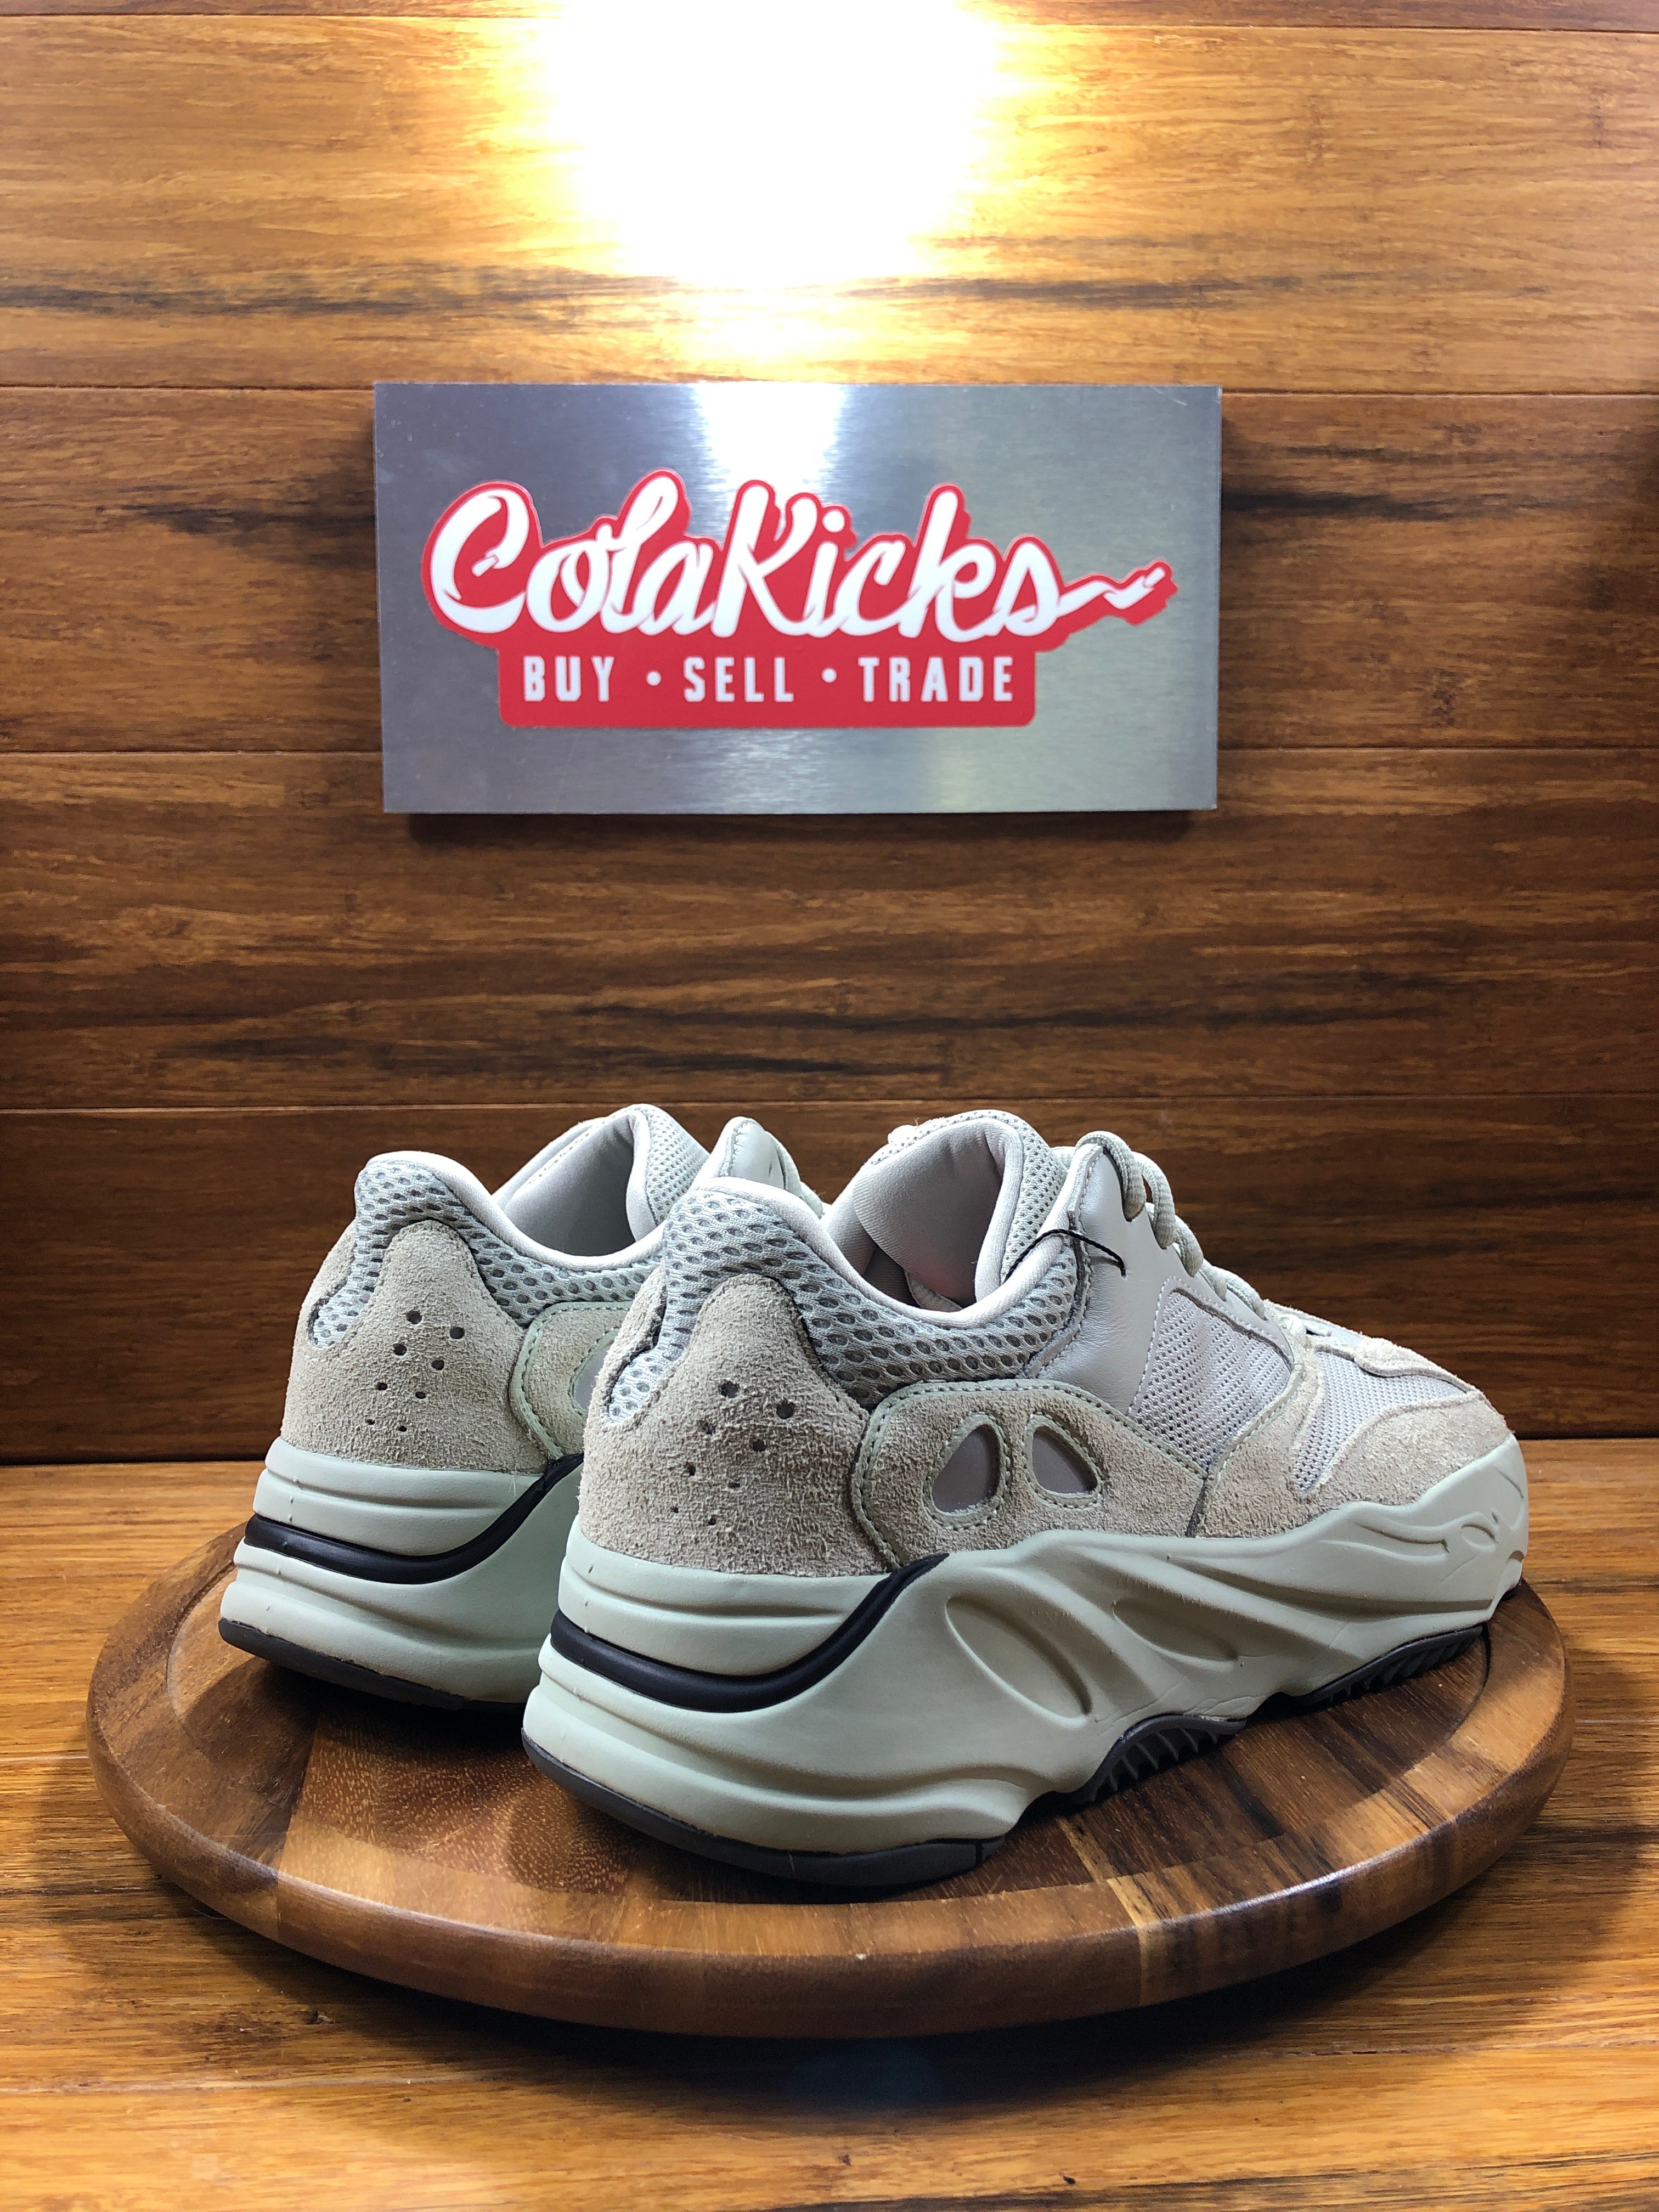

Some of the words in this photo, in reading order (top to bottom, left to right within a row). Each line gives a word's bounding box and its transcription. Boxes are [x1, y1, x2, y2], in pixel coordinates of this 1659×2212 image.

[430, 472, 1166, 642] ColaKicks
[523, 655, 616, 702] BUY
[682, 656, 794, 703] SELL
[857, 656, 1014, 703] TRADE
